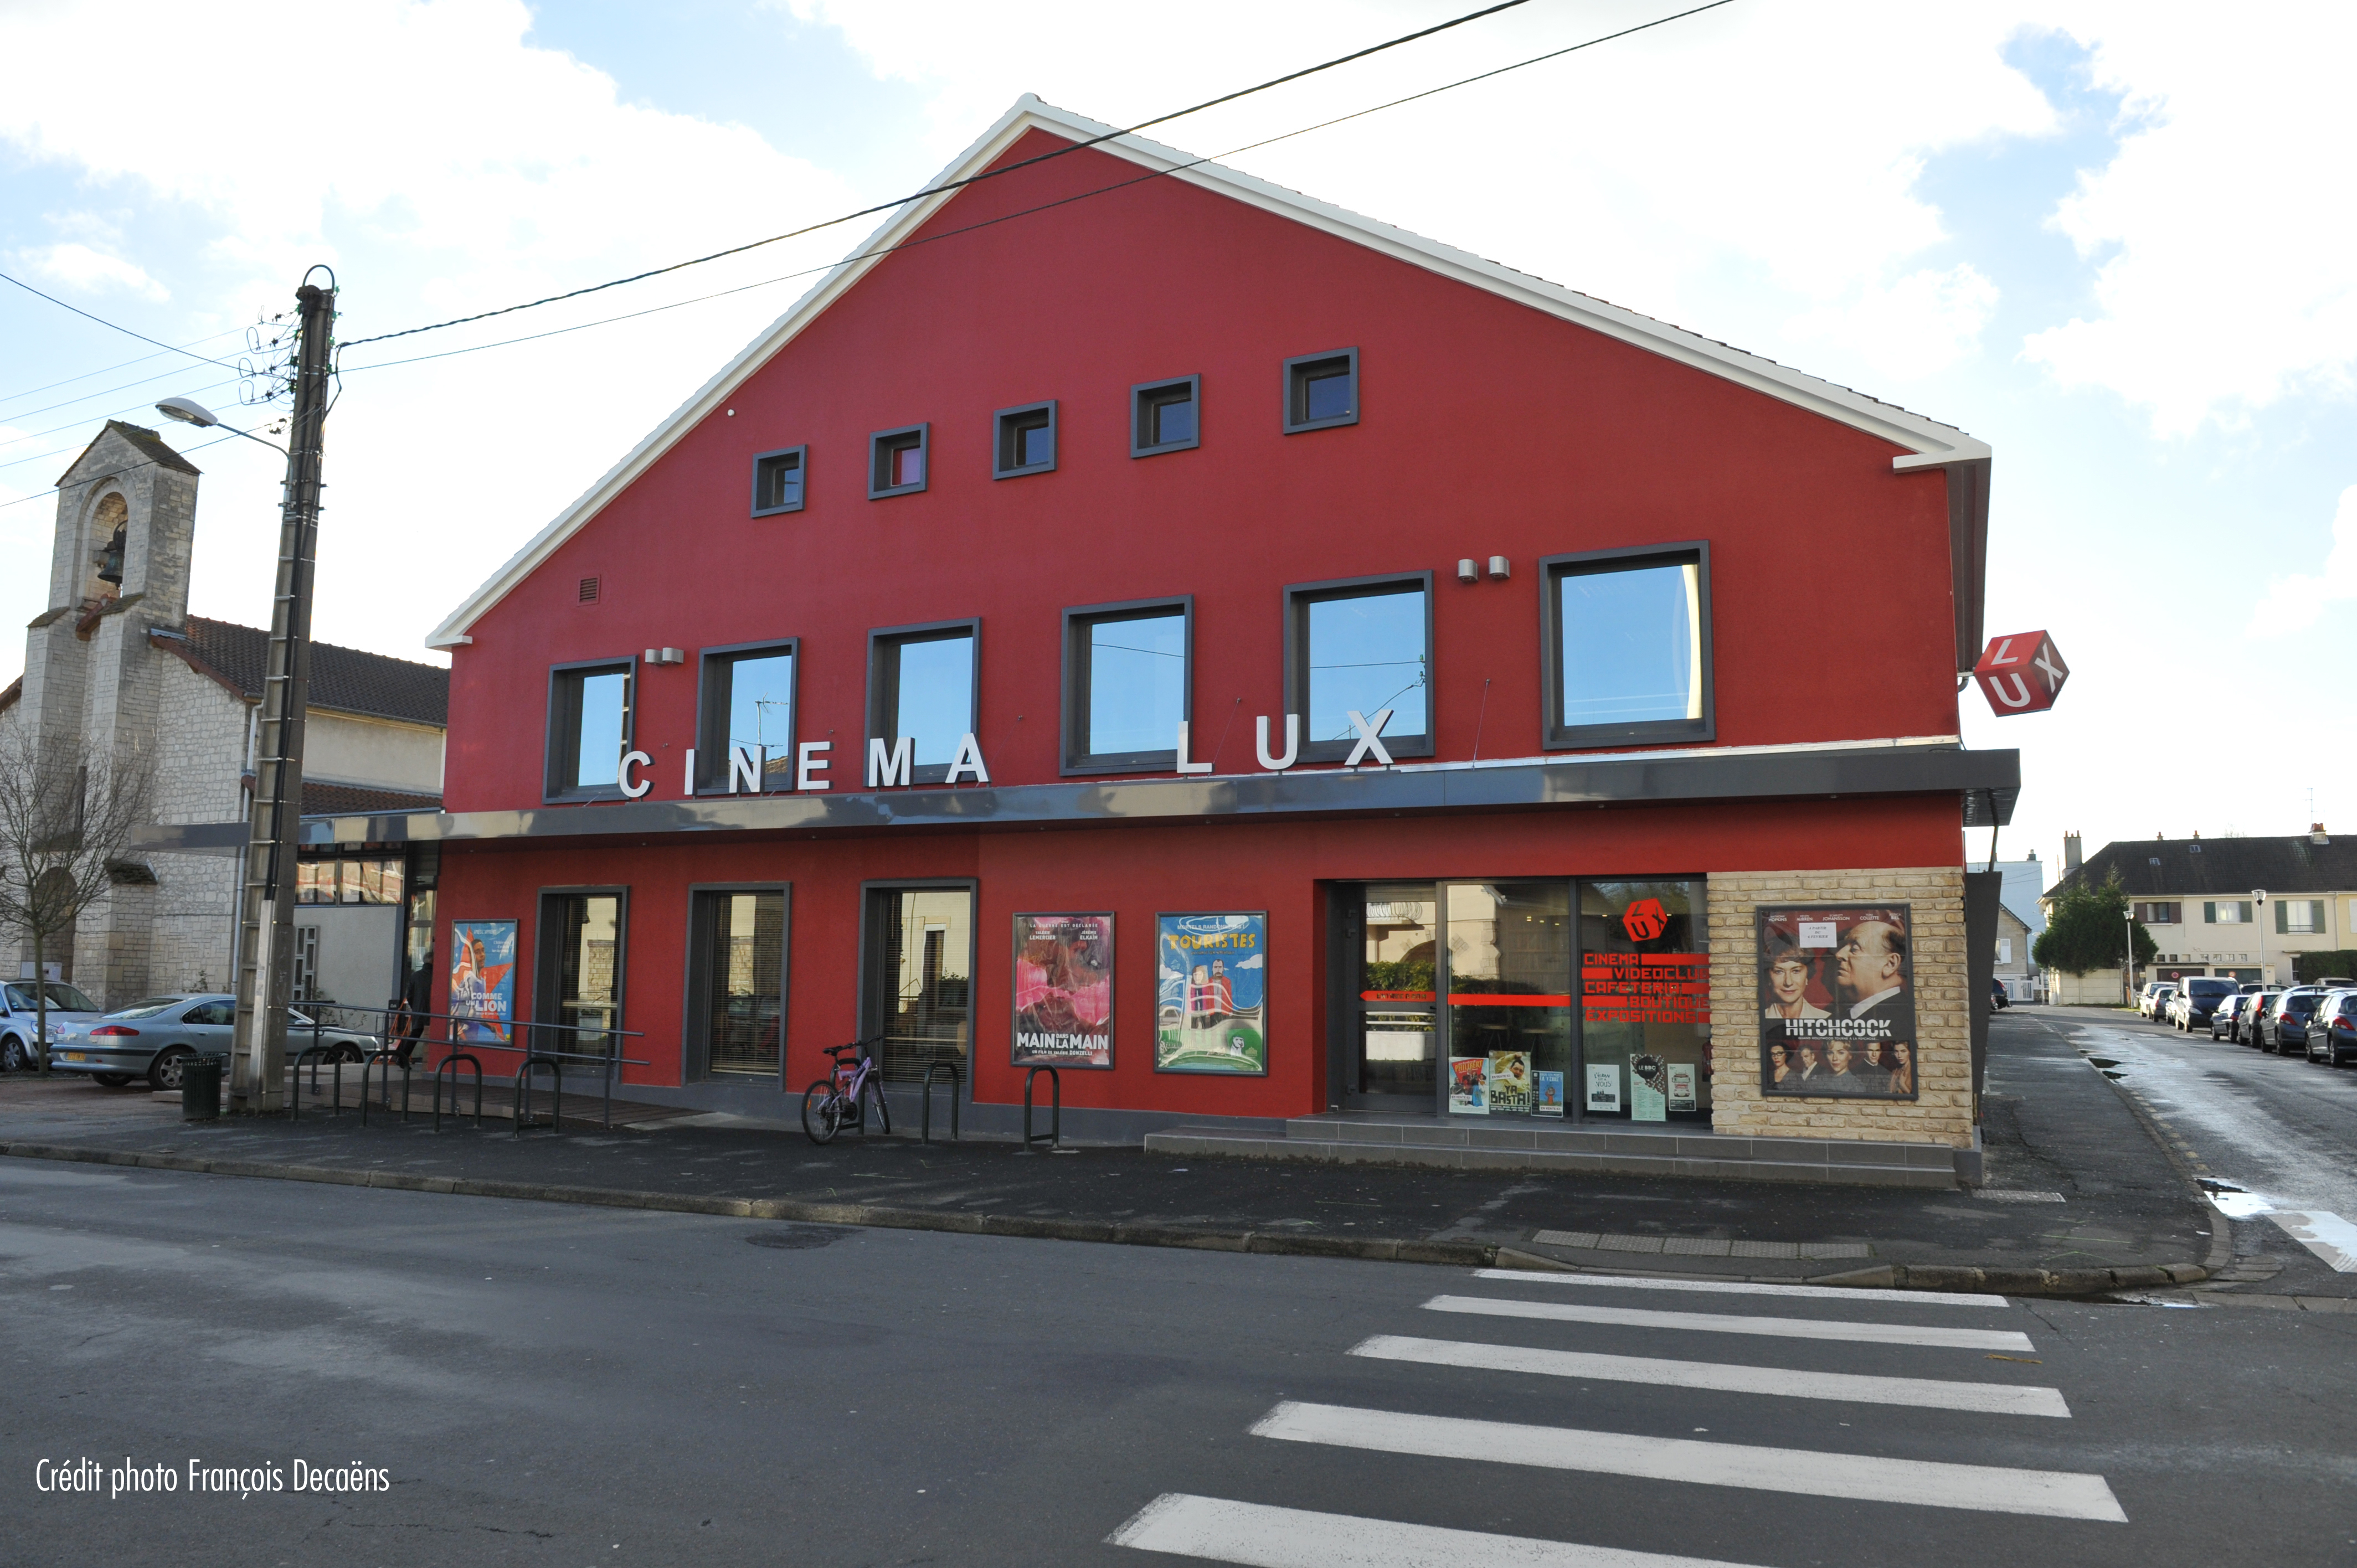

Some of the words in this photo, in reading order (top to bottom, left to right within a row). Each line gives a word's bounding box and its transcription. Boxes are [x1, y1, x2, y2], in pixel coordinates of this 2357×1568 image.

[1988, 638, 2063, 708] LUX
[619, 733, 991, 798] CINEMA
[1177, 709, 1394, 773] LUX
[1168, 933, 1256, 950] TOURISTES
[1584, 953, 1639, 965] CINEMA
[1614, 967, 1710, 980] VIDEOCLUB
[1584, 982, 1680, 994] CAFETERIA
[475, 1000, 507, 1012] LION
[1630, 996, 1710, 1010] BOUTIQUE
[1586, 1009, 1696, 1023] EXPOSITIONS
[1785, 1019, 1892, 1036] HITCHCOCK
[1017, 1033, 1055, 1048] MAIN
[1056, 1039, 1069, 1049] LA
[1070, 1034, 1108, 1050] MAIN
[1505, 1085, 1517, 1095] YA
